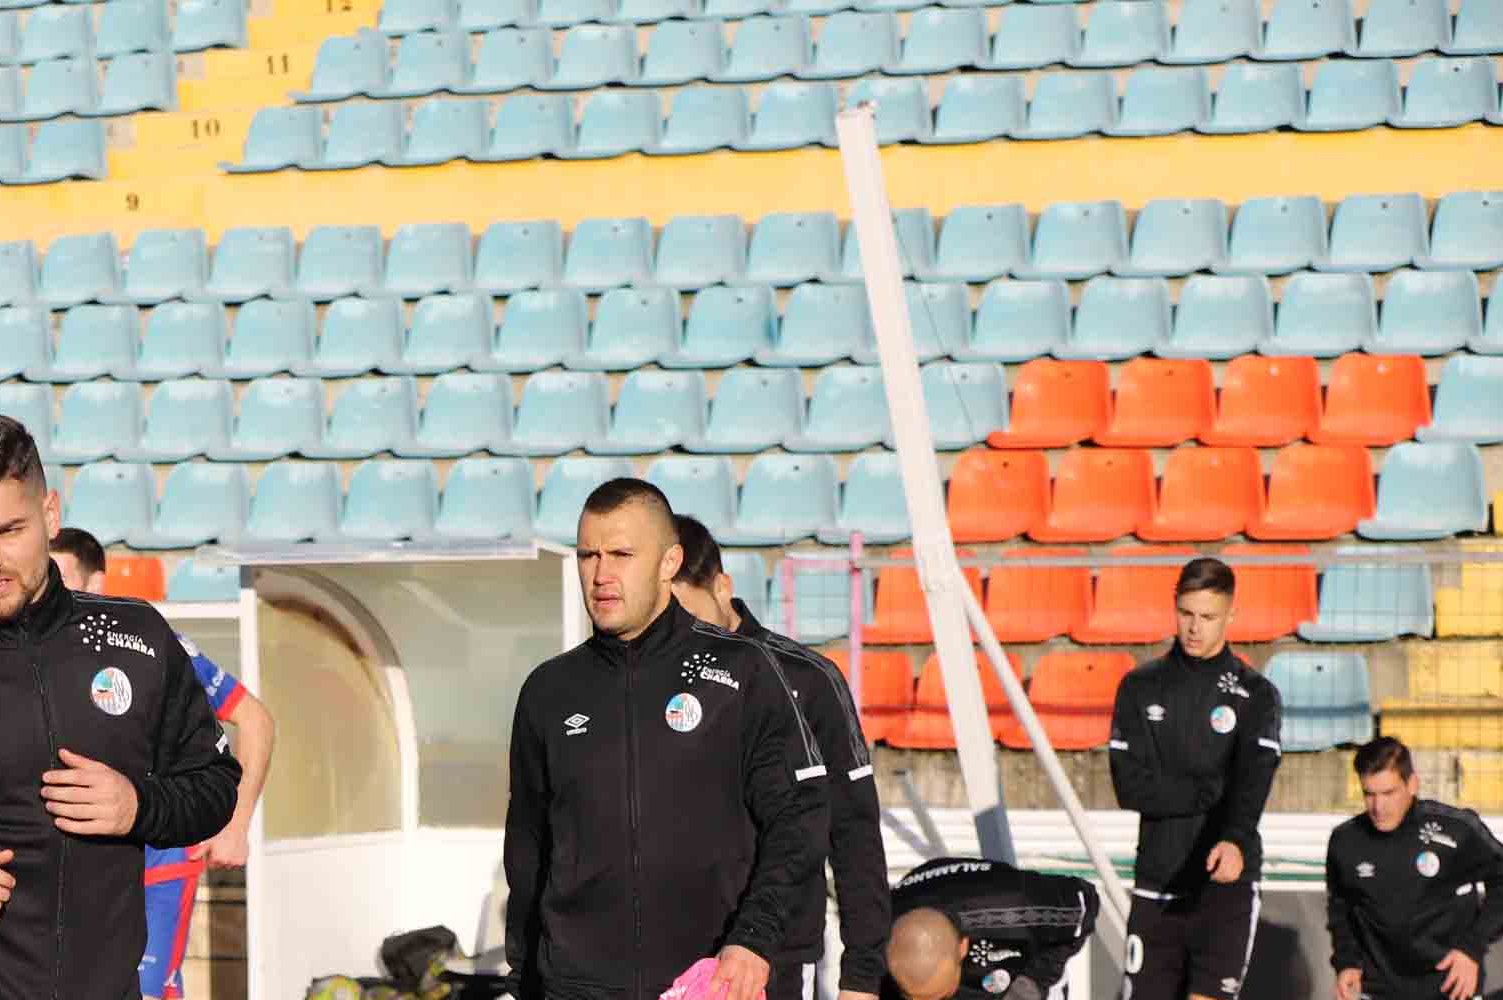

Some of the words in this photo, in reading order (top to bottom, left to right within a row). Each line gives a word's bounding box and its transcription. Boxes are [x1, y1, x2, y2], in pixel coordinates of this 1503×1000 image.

[190, 119, 221, 139] 10
[125, 191, 140, 211] 9
[107, 637, 156, 658] CHARRA
